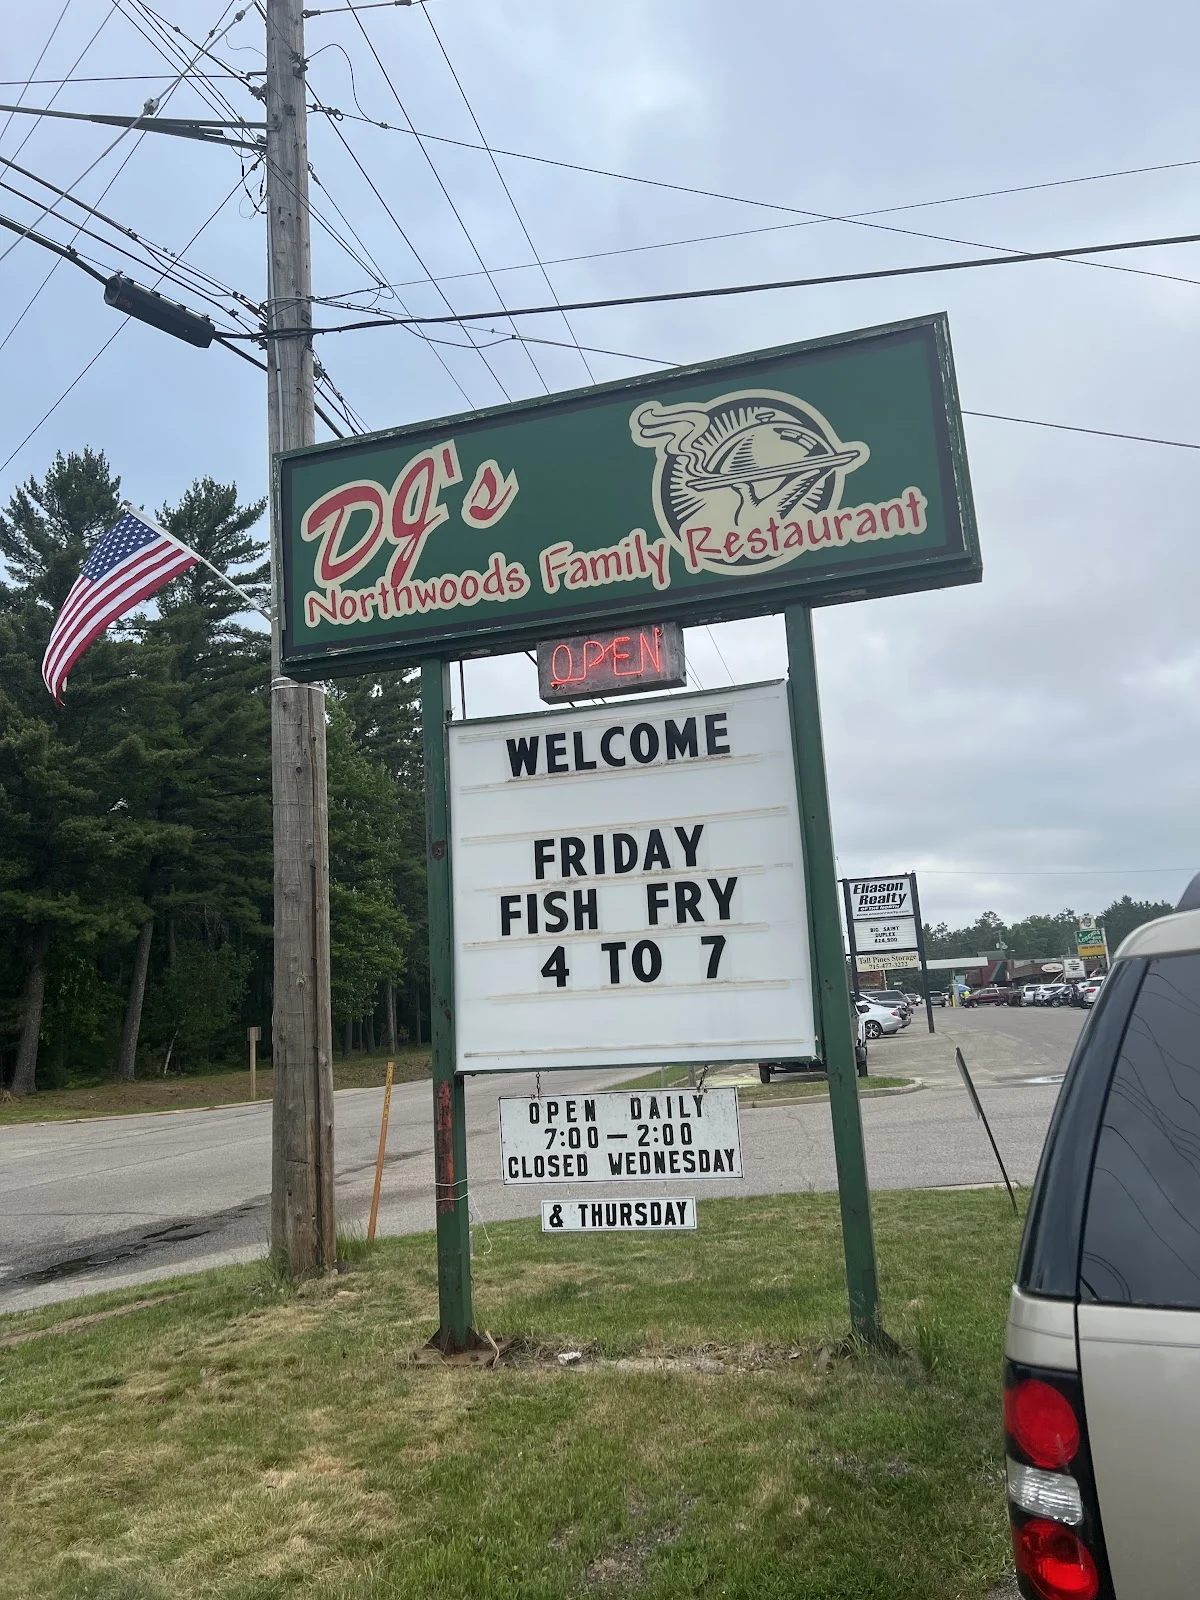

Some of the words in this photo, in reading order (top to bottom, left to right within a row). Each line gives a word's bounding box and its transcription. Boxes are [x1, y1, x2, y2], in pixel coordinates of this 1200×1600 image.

[307, 557, 526, 623] Northwoods
[545, 534, 667, 589] Family
[685, 491, 921, 568] Restaurant
[550, 627, 661, 687] OPEN
[506, 712, 731, 778] WELCOME
[534, 824, 704, 880] FRIDAY
[500, 888, 599, 936] FISH
[646, 876, 738, 926] FRY
[853, 882, 903, 894] Eliason
[859, 892, 907, 906] Realty
[540, 945, 570, 988] 4
[600, 938, 663, 985] TO
[700, 934, 727, 980] 7
[891, 954, 917, 962] Storage
[529, 1099, 597, 1125] OPEN
[630, 1095, 704, 1121] DAILY
[508, 1153, 589, 1179] CLOSED
[607, 1148, 735, 1176] WEDNESDAY
[549, 1204, 564, 1228] &
[578, 1201, 687, 1228] THURSDAY
